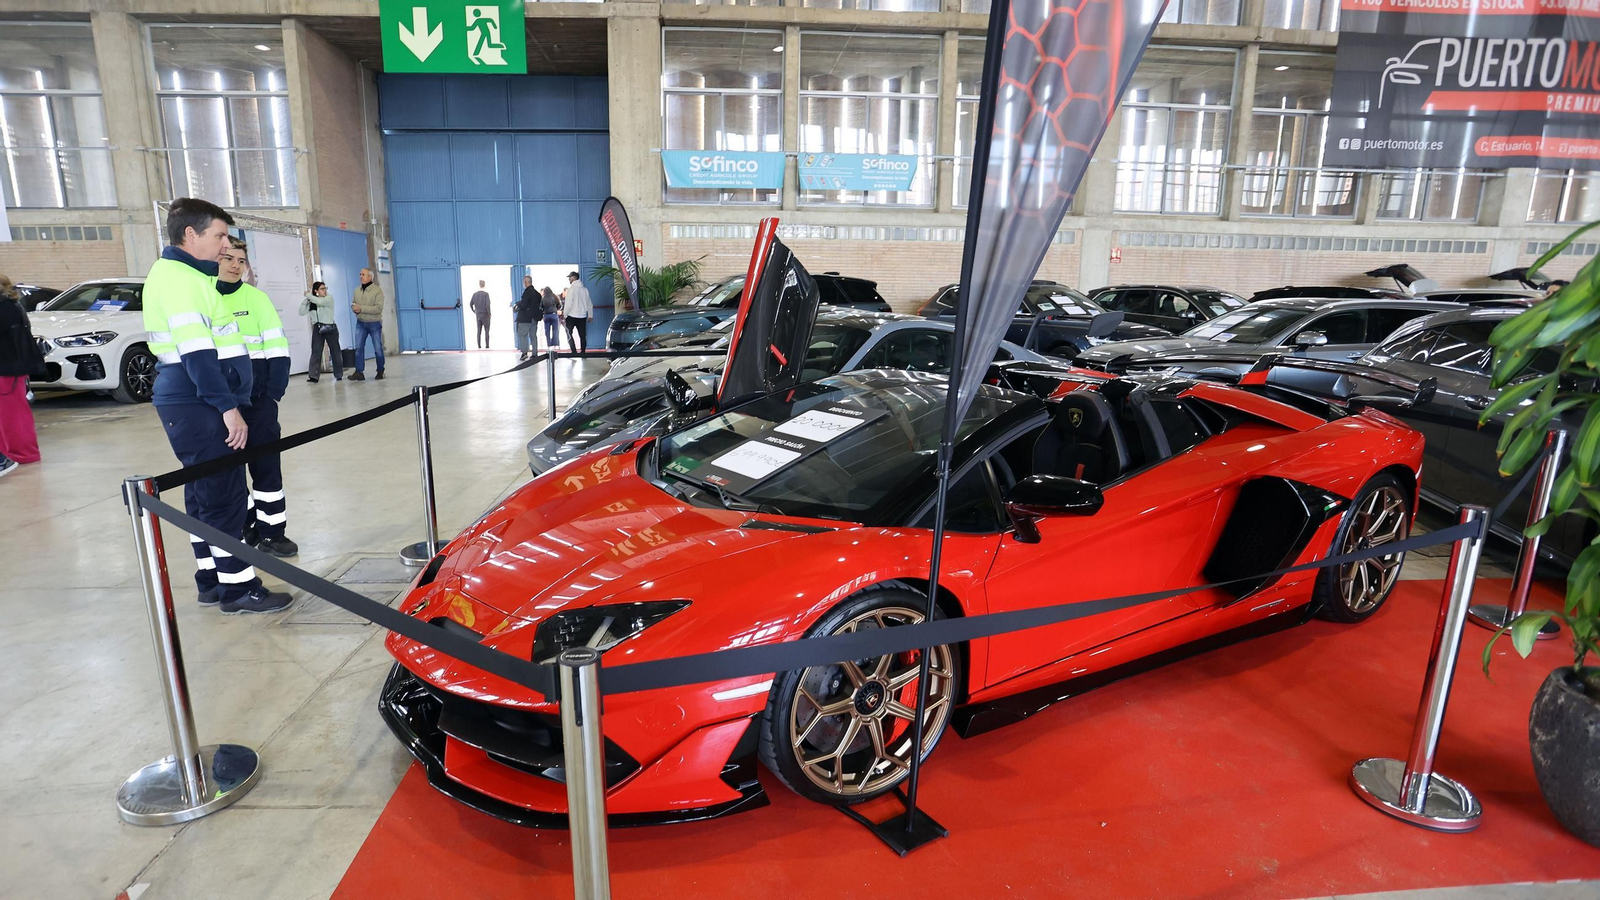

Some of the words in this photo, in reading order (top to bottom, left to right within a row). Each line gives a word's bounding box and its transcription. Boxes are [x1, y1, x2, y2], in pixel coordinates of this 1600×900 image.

[1482, 0, 1525, 10] STOCK
[1363, 138, 1444, 151] puertomotor.es
[1490, 141, 1533, 152] Estuario,
[1567, 144, 1599, 156] puerto
[689, 155, 758, 173] Sofinco
[862, 158, 909, 171] Sofinco
